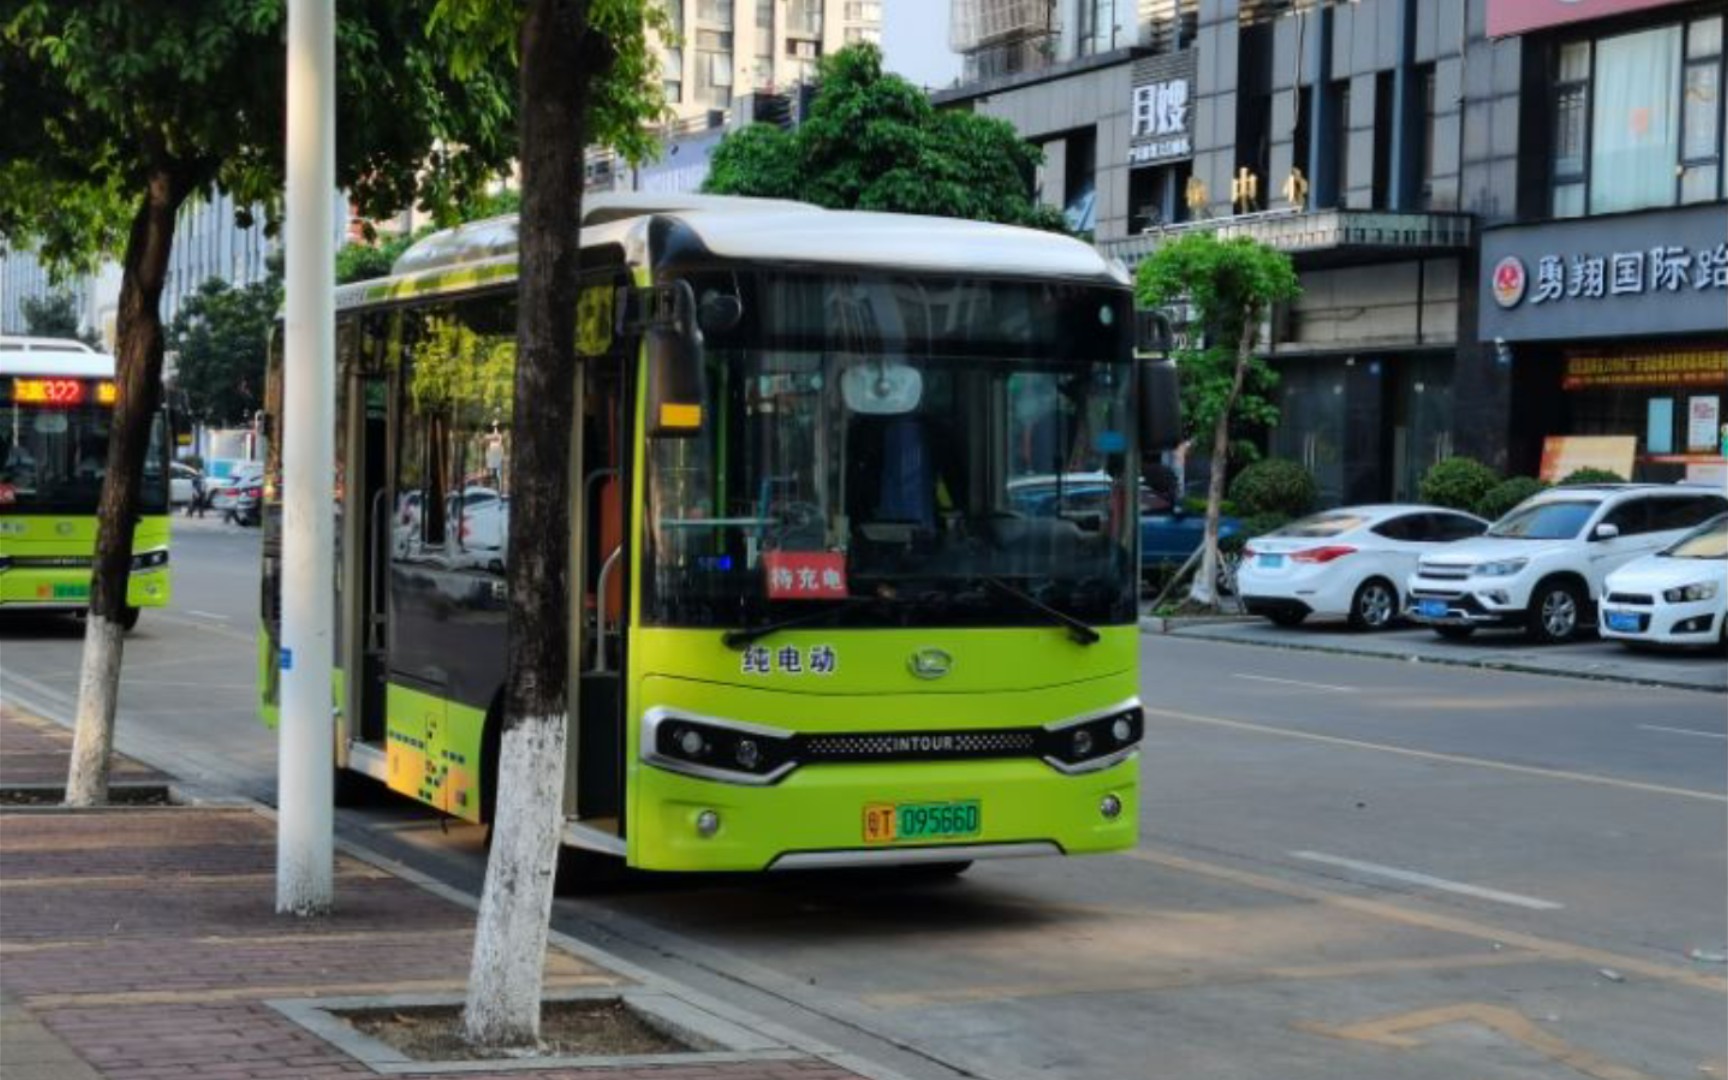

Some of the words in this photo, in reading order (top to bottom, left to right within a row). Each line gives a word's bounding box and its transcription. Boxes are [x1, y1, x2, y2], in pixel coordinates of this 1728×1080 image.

[1131, 79, 1189, 136] 月嫂
[741, 644, 837, 675] 纯电动
